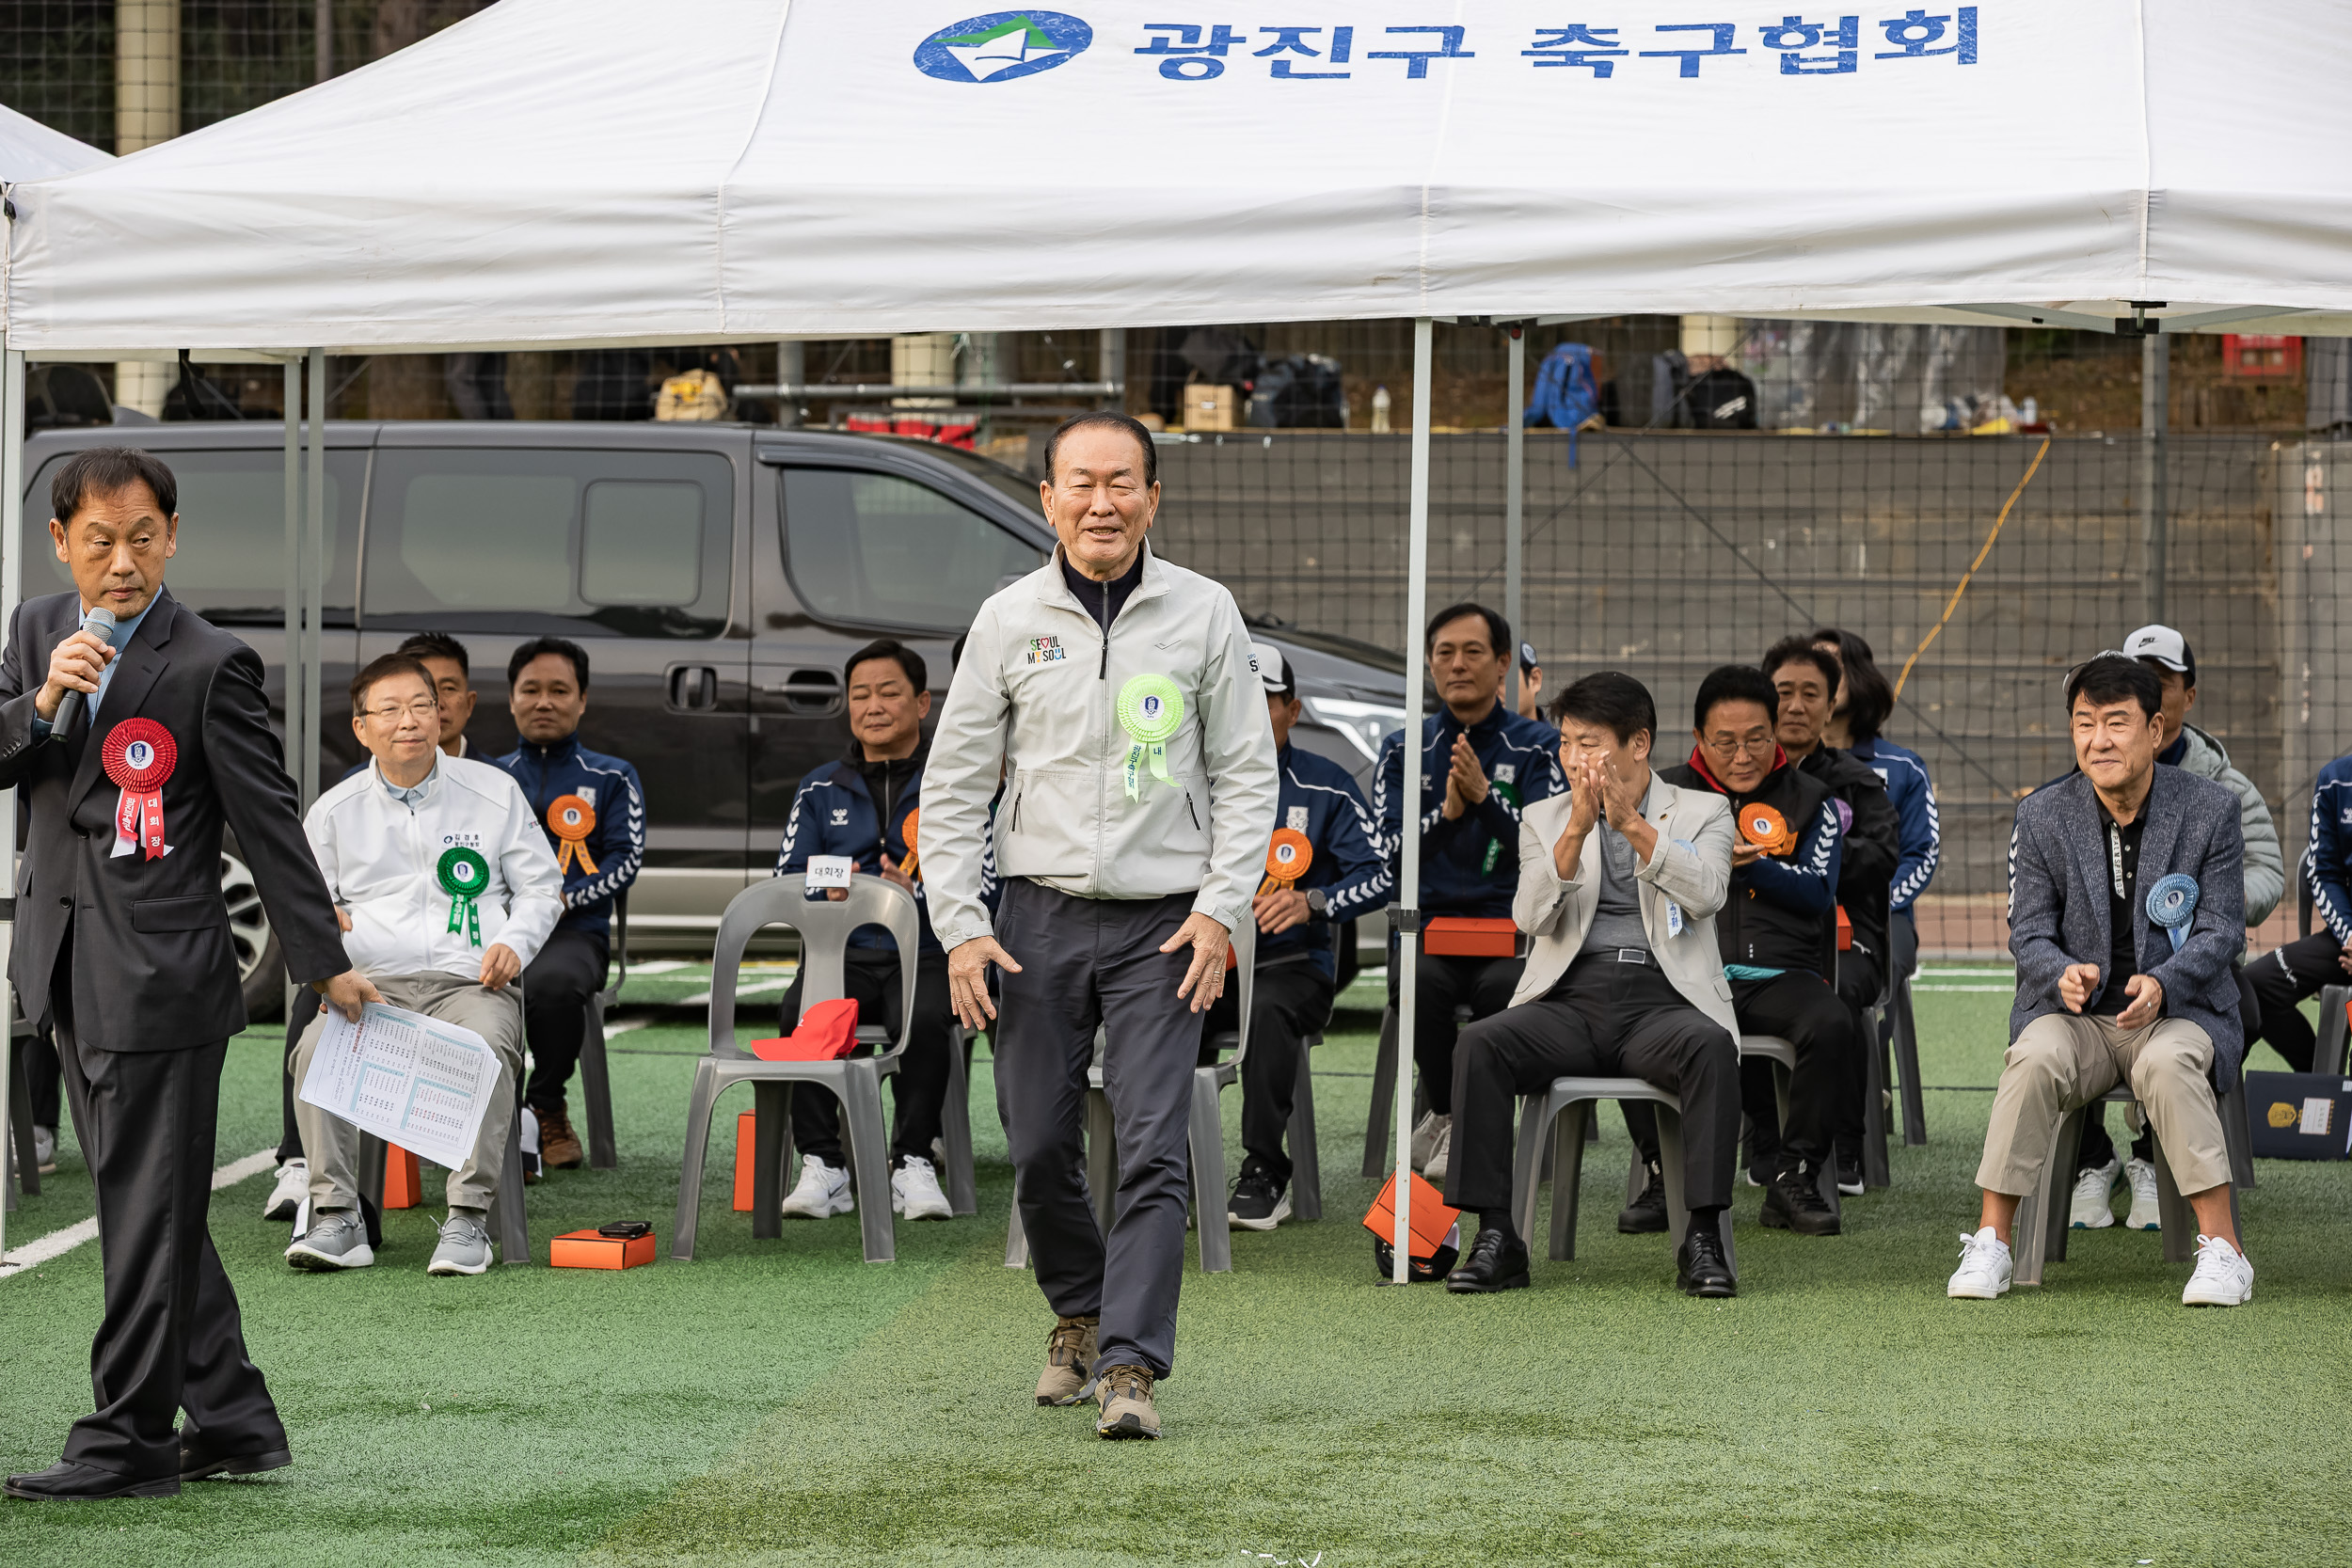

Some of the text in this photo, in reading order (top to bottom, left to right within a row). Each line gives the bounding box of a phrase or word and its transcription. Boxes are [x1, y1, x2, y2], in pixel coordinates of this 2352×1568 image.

[1134, 6, 1978, 81] 광진구 축구협회
[815, 867, 844, 879] 대회장
